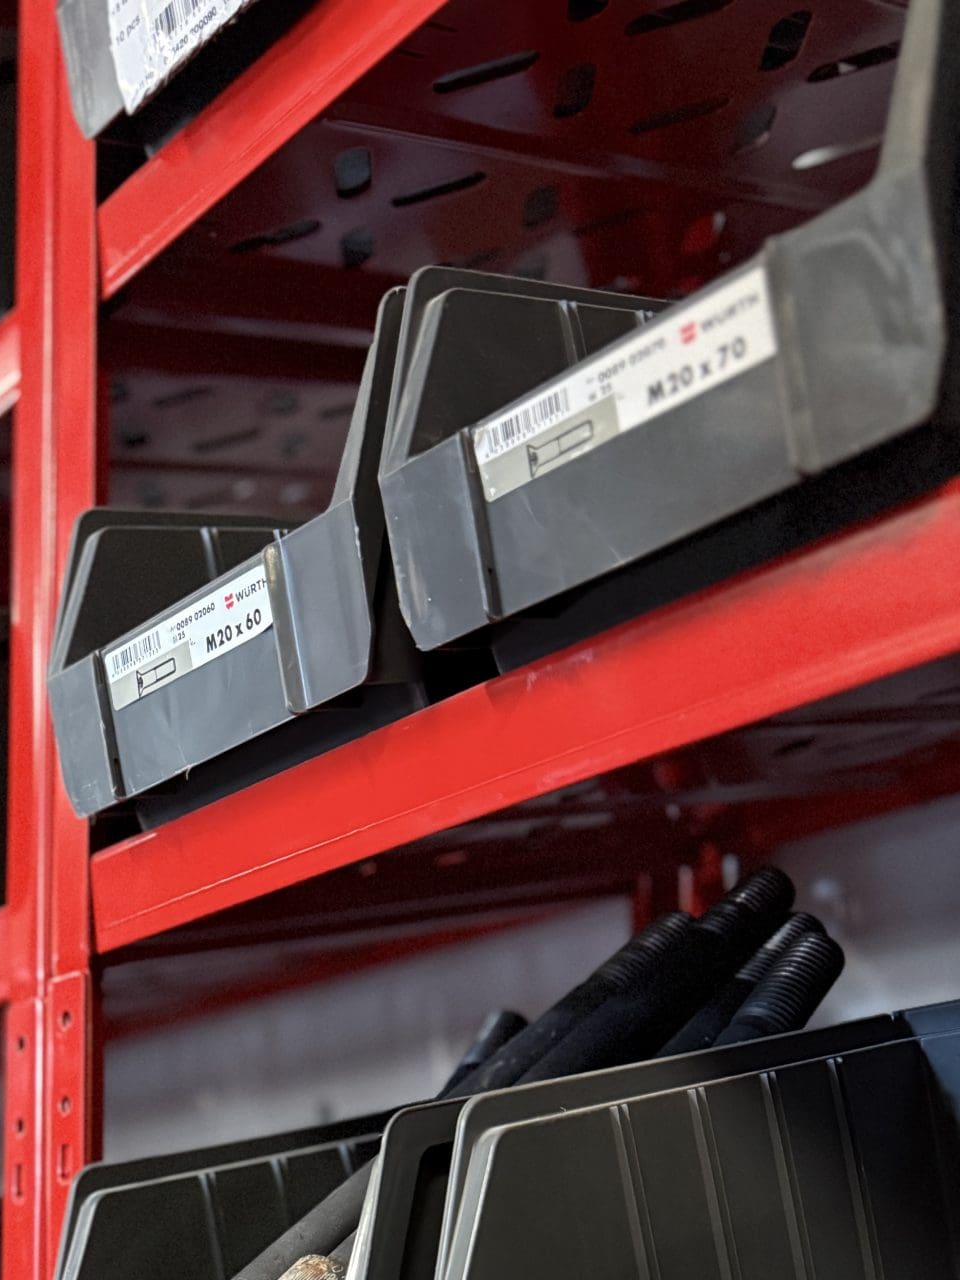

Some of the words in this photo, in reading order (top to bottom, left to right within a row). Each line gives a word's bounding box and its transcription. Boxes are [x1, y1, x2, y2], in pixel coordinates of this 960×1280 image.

[126, 15, 141, 37] pcs
[647, 364, 695, 405] M20
[699, 361, 711, 379] x
[716, 336, 746, 368] 70
[176, 615, 193, 631] 0089
[193, 602, 216, 621] 02060
[206, 624, 233, 653] M20
[235, 622, 244, 638] x
[245, 608, 262, 630] 60
[177, 631, 186, 641] 25
